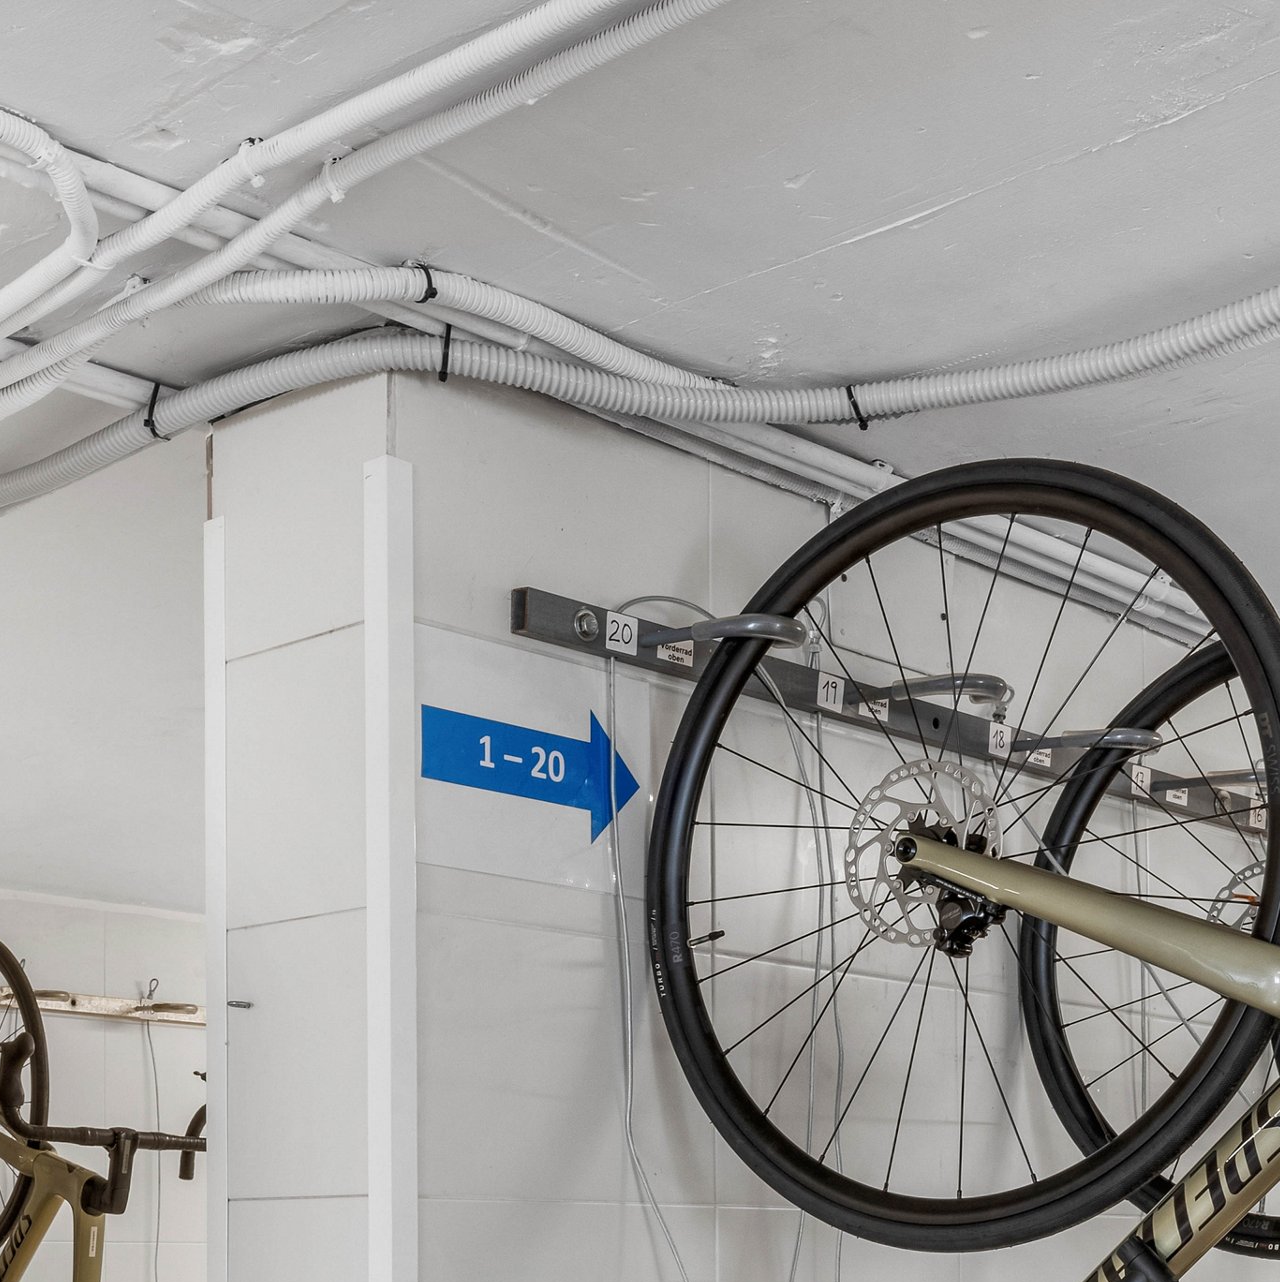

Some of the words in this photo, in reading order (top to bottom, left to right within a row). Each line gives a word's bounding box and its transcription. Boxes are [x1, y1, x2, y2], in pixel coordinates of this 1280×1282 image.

[608, 619, 633, 645] 20
[668, 654, 685, 664] oben
[822, 679, 838, 705] 19
[992, 728, 1005, 750] 18
[478, 734, 495, 769] 1
[531, 746, 565, 784] 20
[1267, 744, 1280, 795] SWISS
[1253, 808, 1263, 824] 16
[670, 931, 684, 963] R470
[654, 962, 667, 998] TURBO
